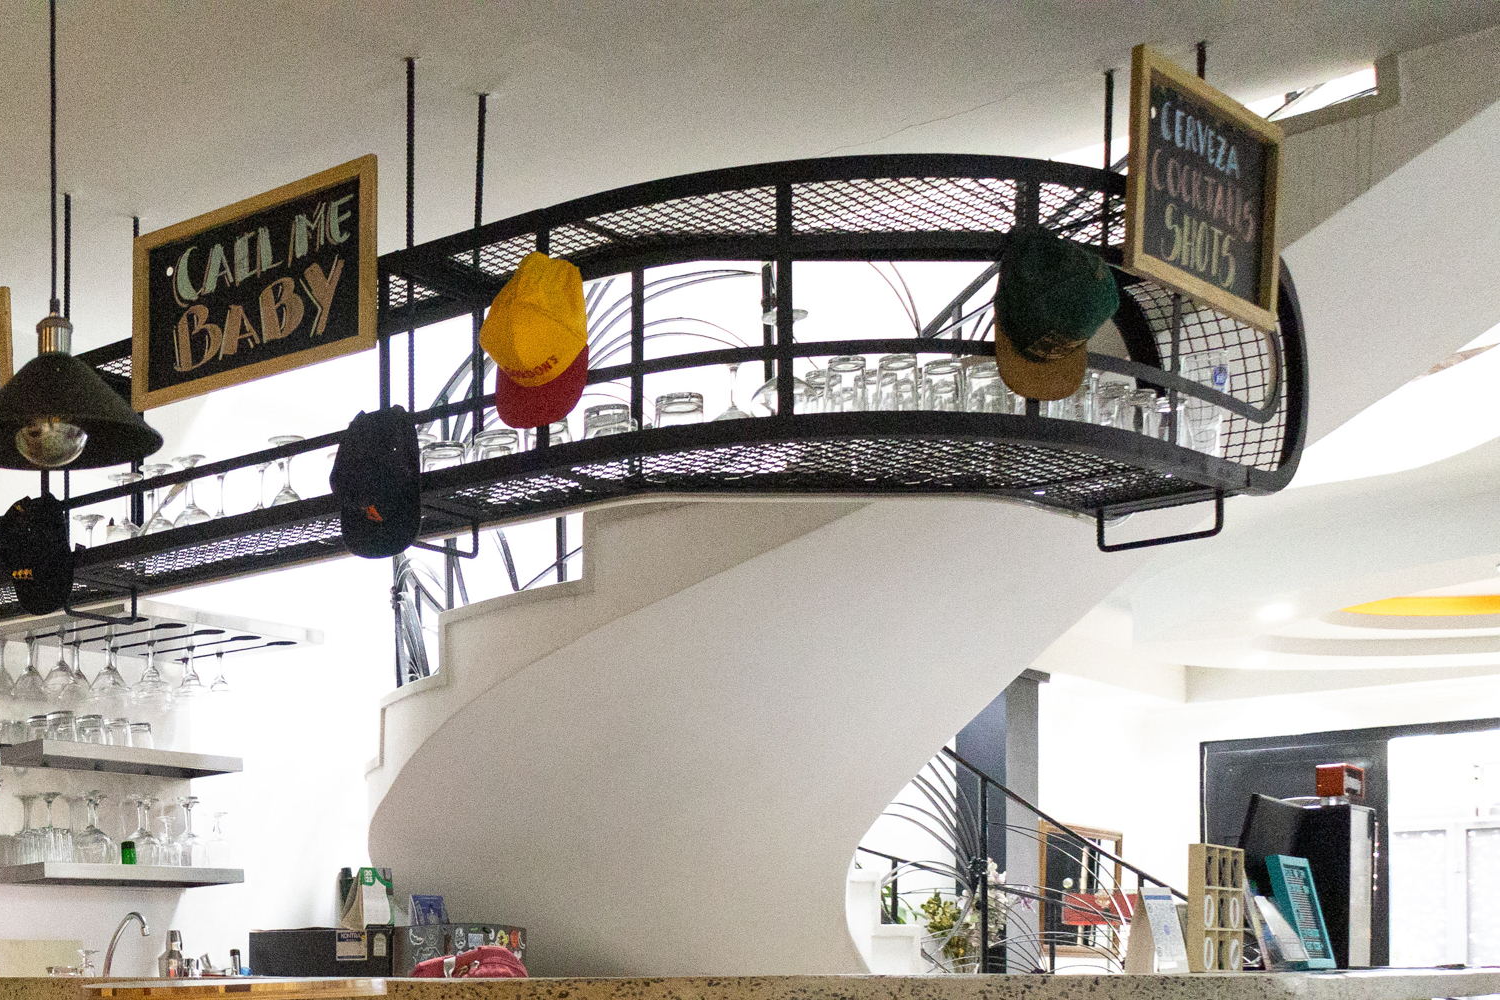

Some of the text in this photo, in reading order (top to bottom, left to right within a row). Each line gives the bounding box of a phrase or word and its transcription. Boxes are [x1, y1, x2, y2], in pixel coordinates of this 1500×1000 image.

[1161, 102, 1240, 180] CERVEZA
[173, 194, 354, 308] CALL ME
[1161, 203, 1236, 288] SHOTS
[173, 254, 345, 372] BABY
